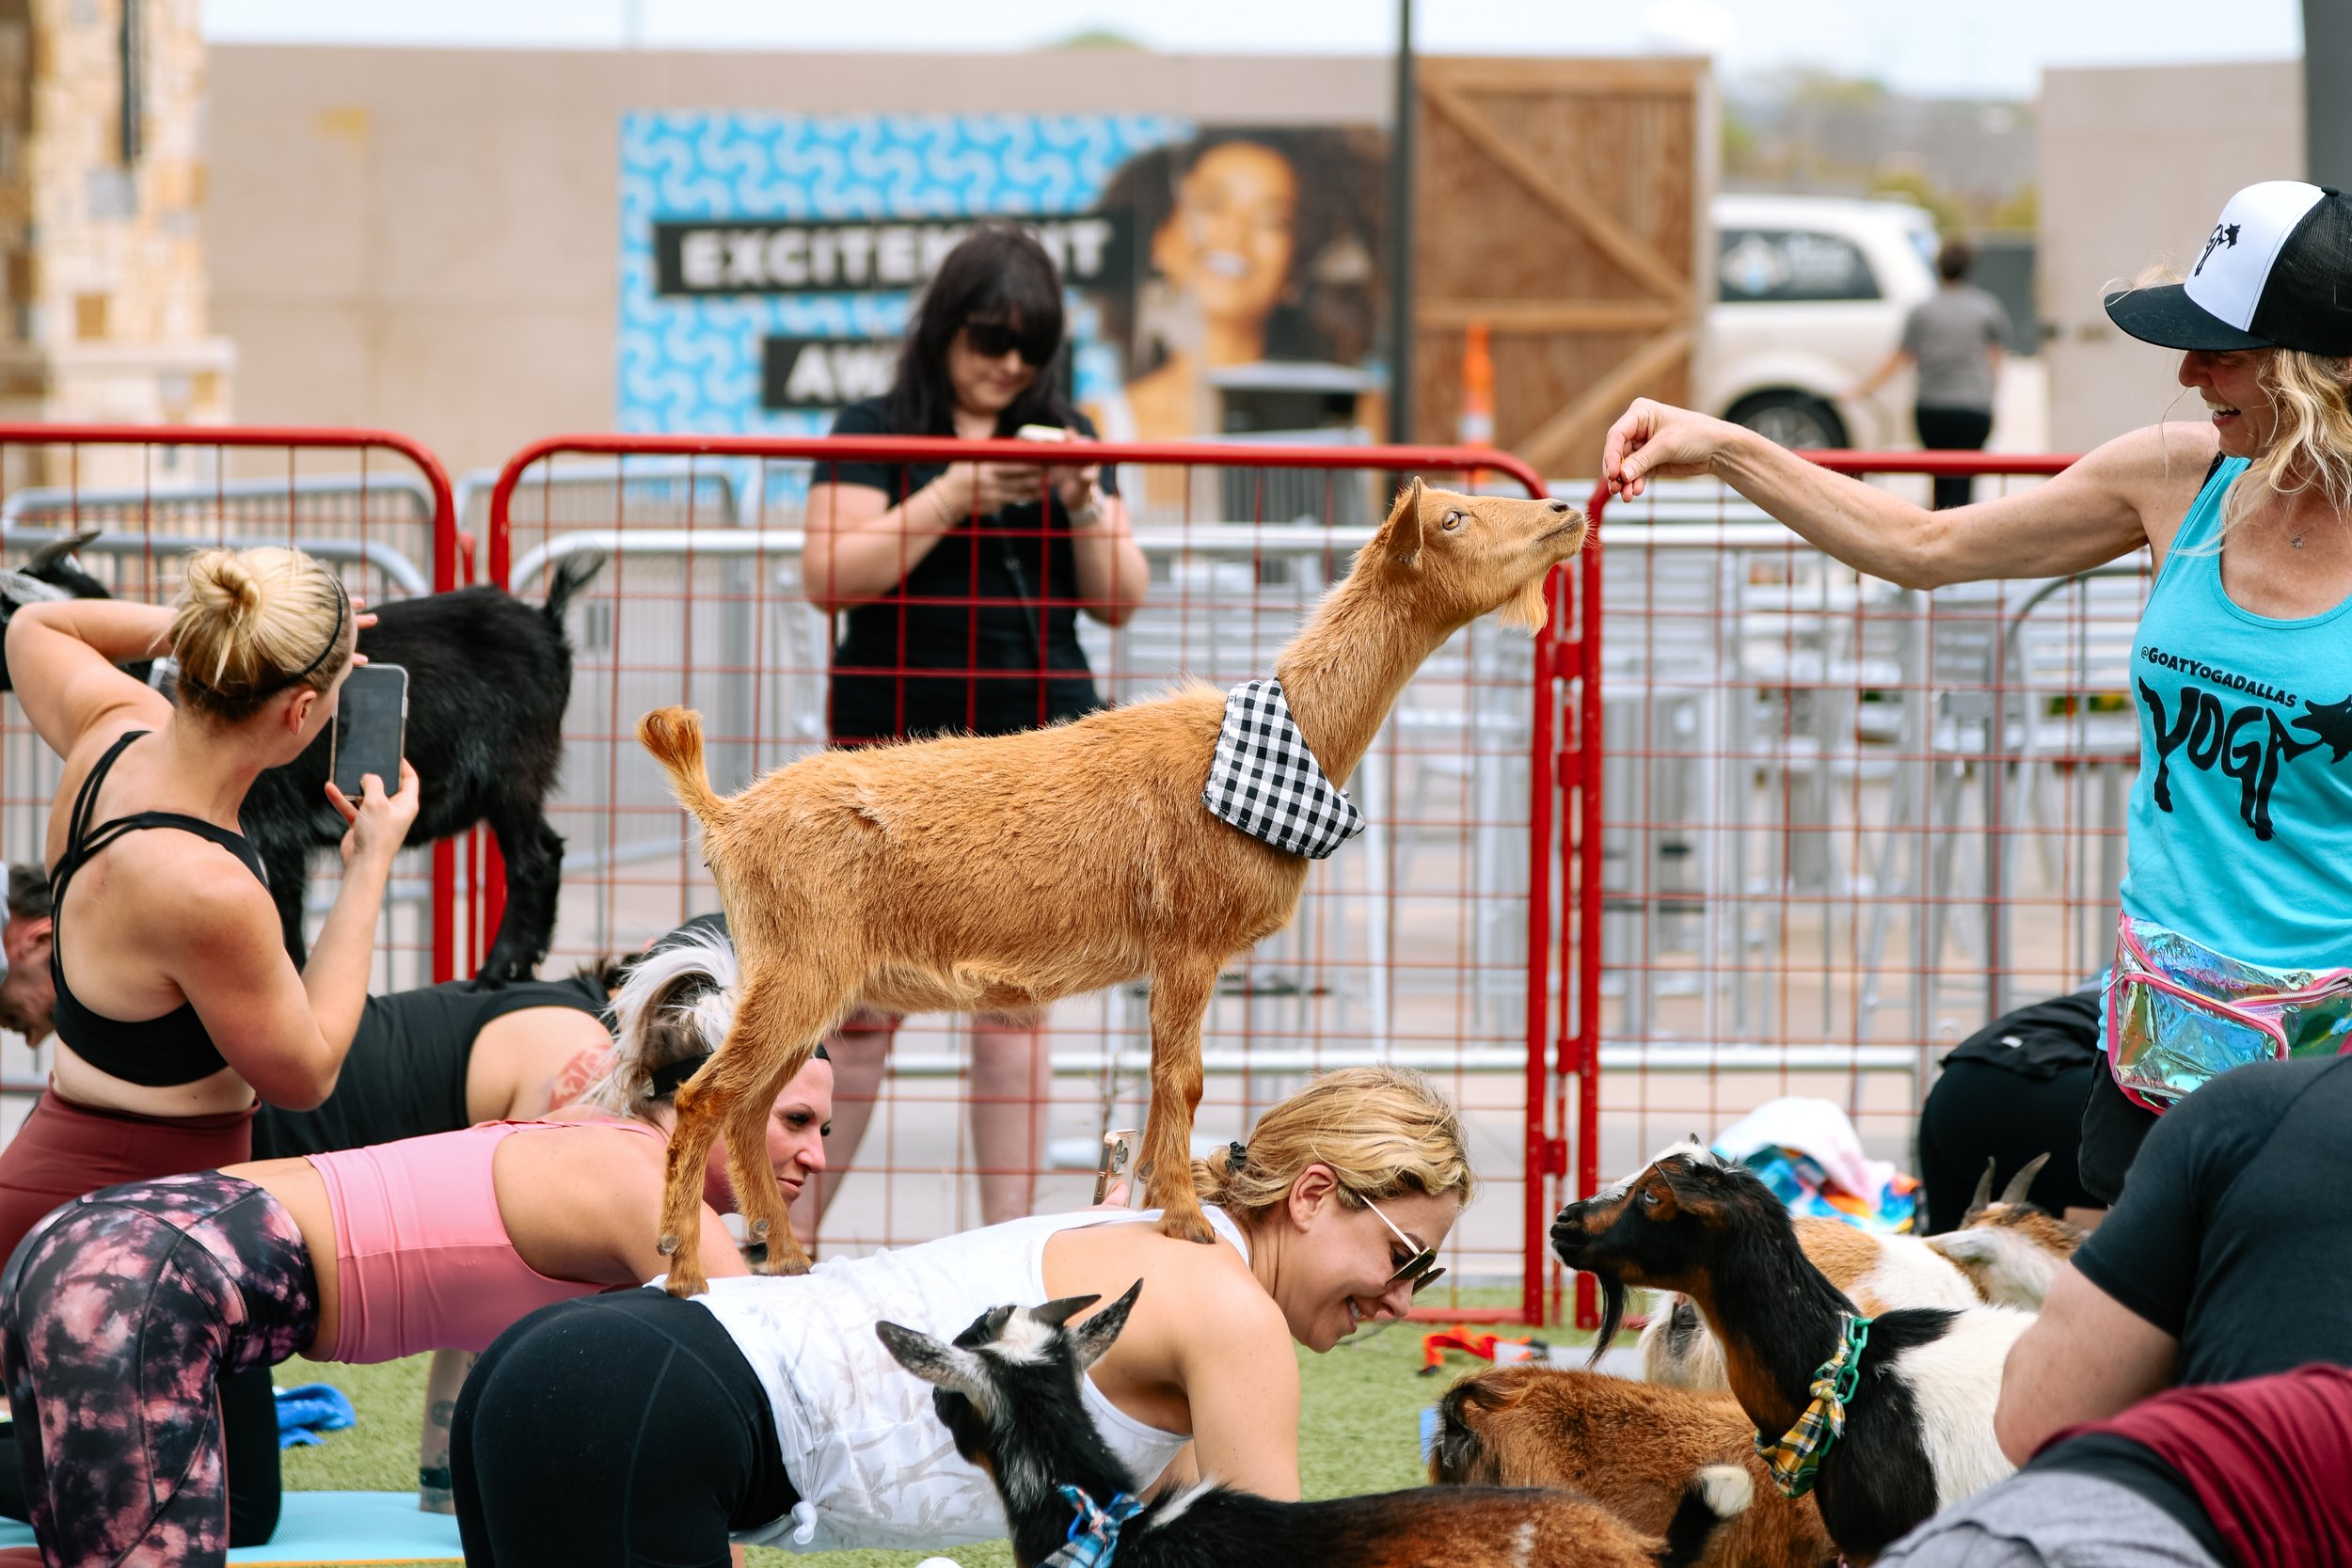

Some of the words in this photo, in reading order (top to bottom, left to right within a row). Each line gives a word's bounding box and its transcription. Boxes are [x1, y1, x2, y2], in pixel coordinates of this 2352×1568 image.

[679, 219, 1112, 286] EXCITEMNT
[2140, 646, 2296, 707] @GOATYOGADALLAS
[2138, 676, 2310, 841] YOGA
